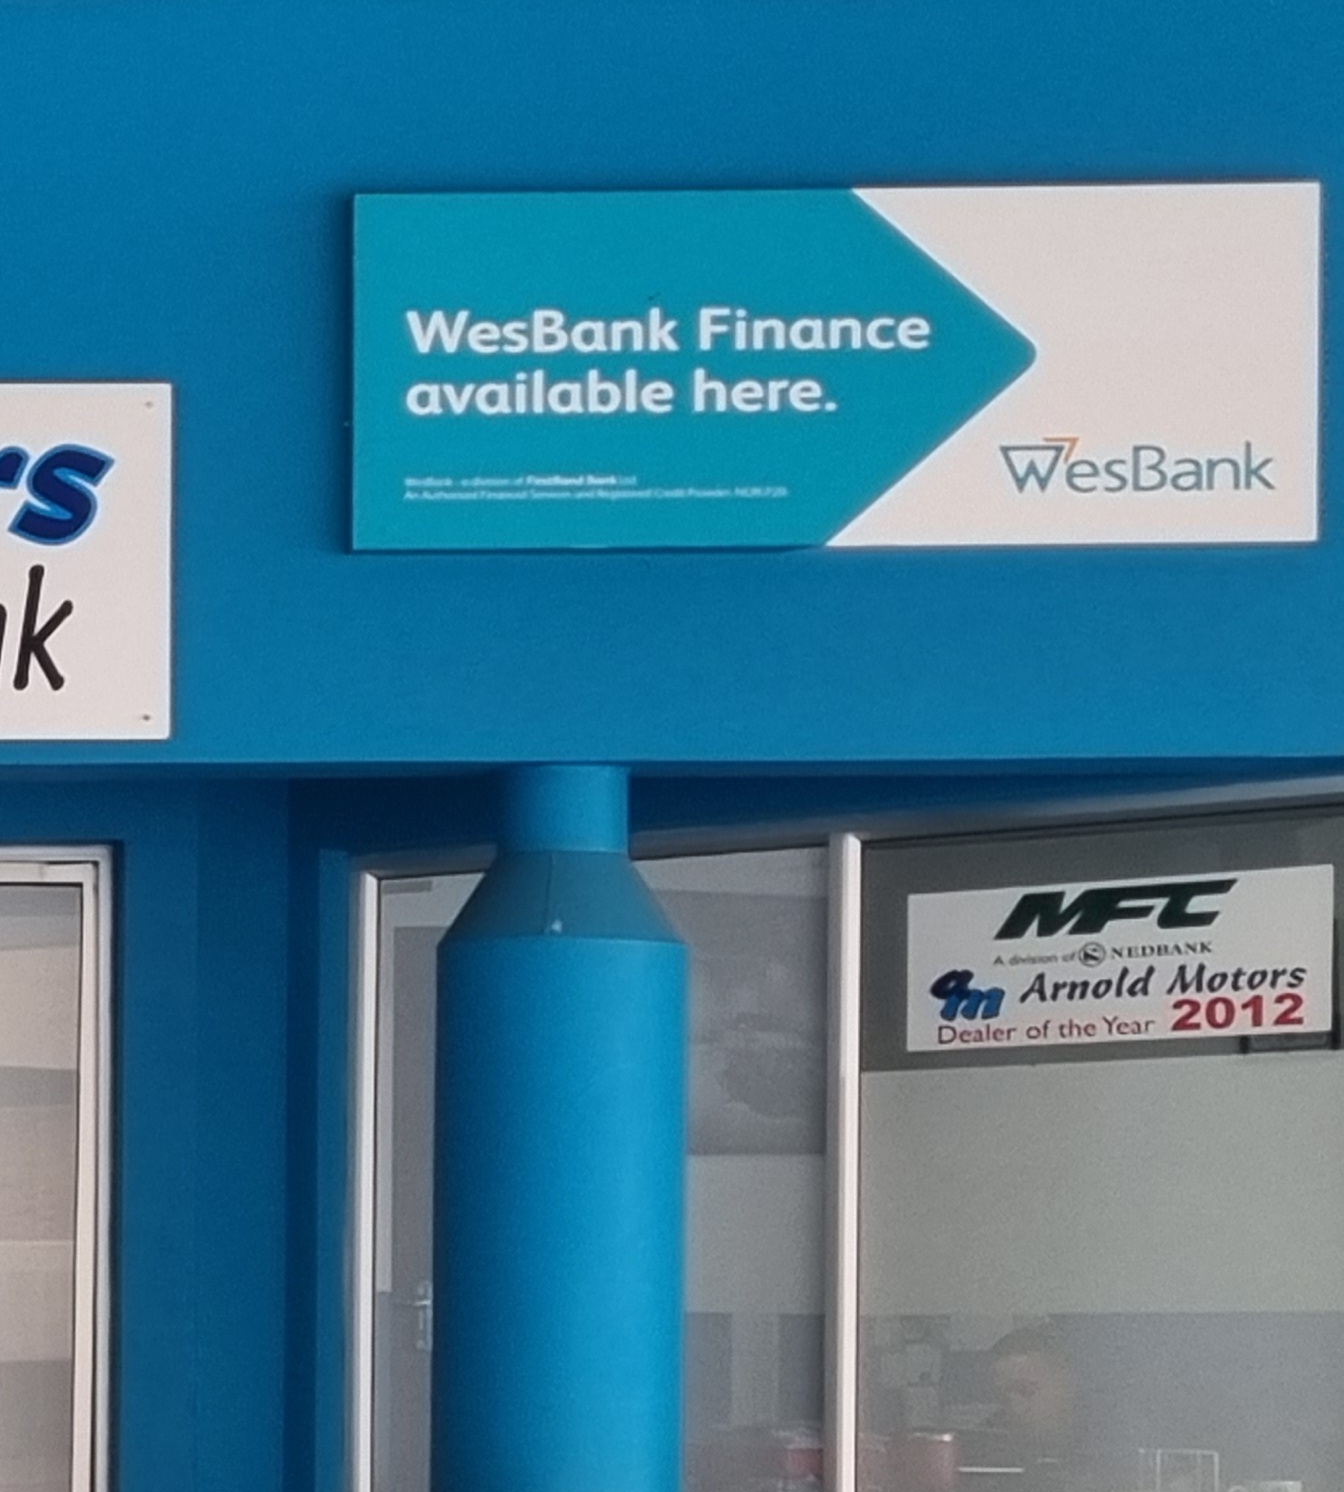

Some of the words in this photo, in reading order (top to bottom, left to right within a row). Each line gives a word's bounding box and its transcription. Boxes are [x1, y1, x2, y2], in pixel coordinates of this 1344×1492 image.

[404, 307, 680, 356] WesBank
[698, 305, 931, 351] Finance
[404, 367, 675, 416] available
[692, 367, 839, 414] here.
[999, 436, 1277, 494] WesBank
[994, 878, 1239, 941] MFC
[1111, 940, 1213, 960] NEDBANK
[1019, 965, 1154, 1004] Arnold
[1166, 964, 1307, 996] Motors
[938, 1022, 1016, 1045] Dealer
[1026, 1020, 1051, 1039] of
[1058, 1018, 1097, 1038] the
[1102, 1016, 1155, 1036] Year
[1171, 992, 1305, 1032] 2012
